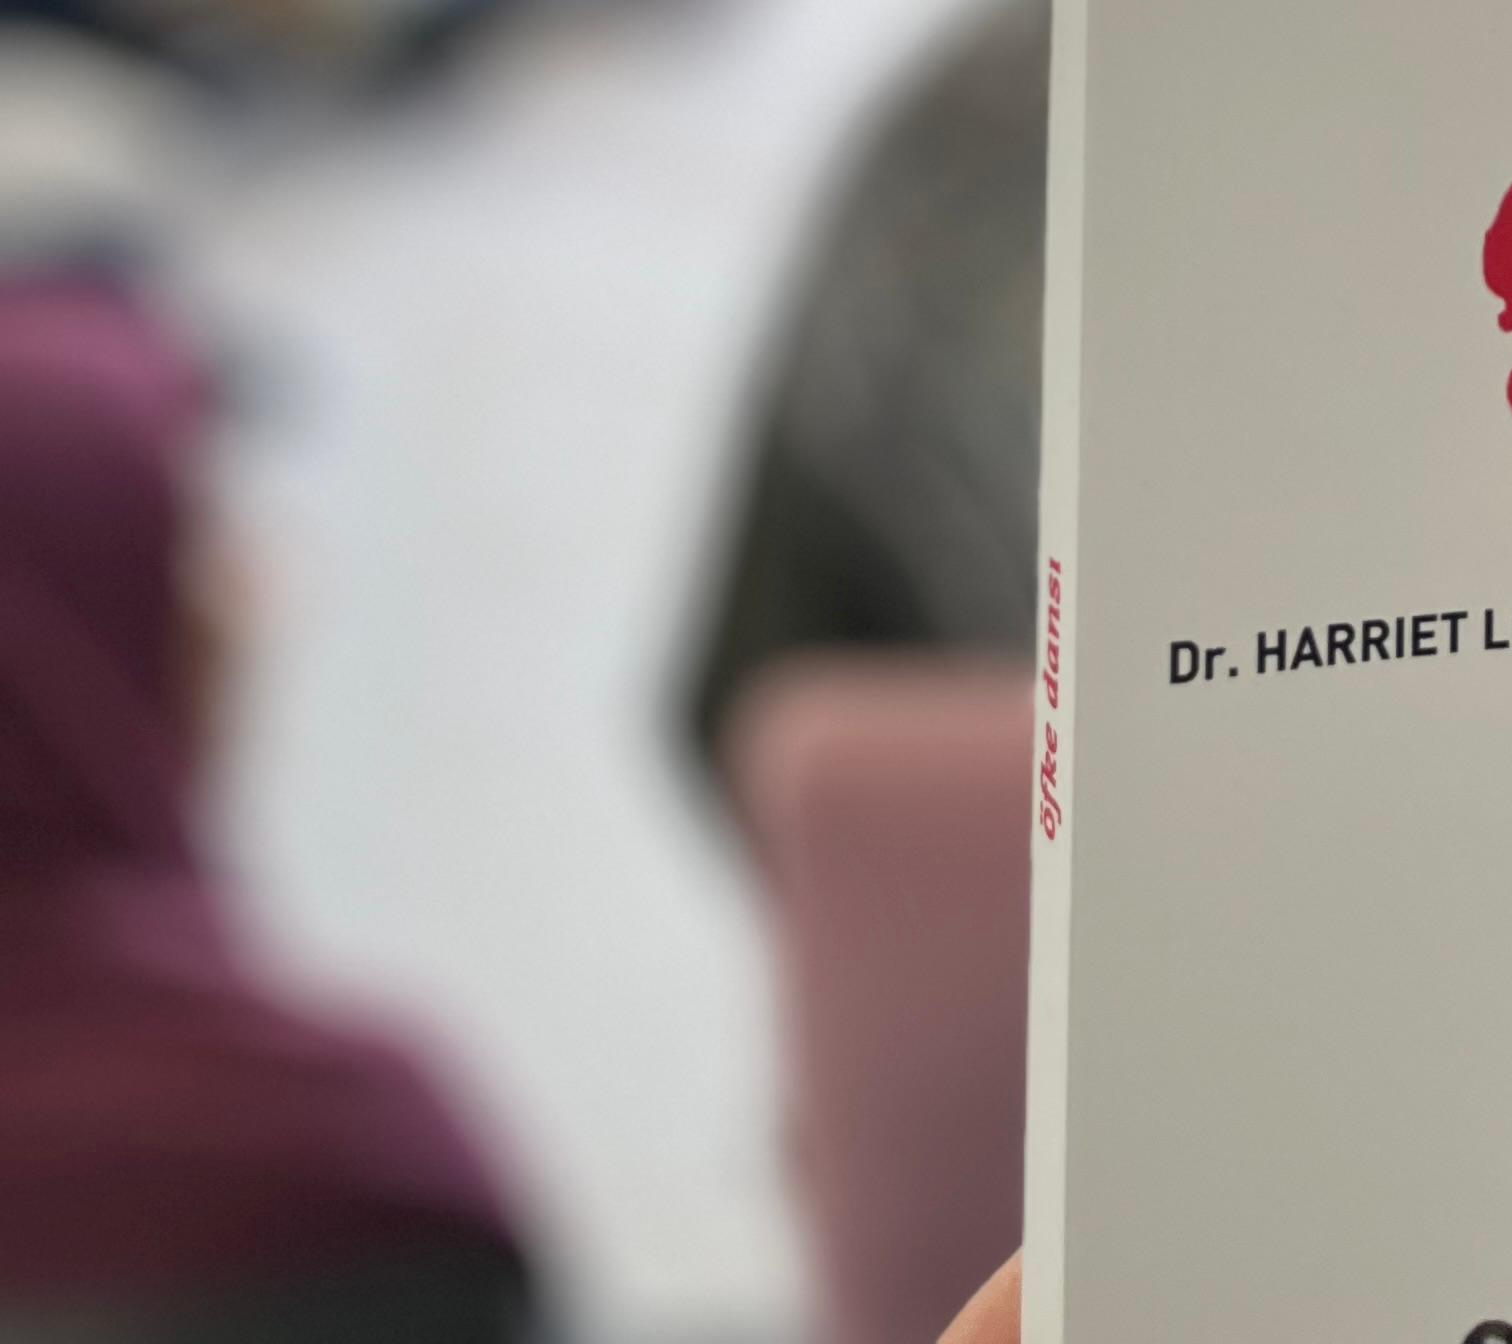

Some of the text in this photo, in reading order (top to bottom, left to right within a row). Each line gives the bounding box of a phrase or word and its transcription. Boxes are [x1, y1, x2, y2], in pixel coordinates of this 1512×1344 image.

[1040, 557, 1062, 842] öfke dansı
[1168, 639, 1240, 686] Dr.
[1255, 609, 1470, 676] HARRIET
